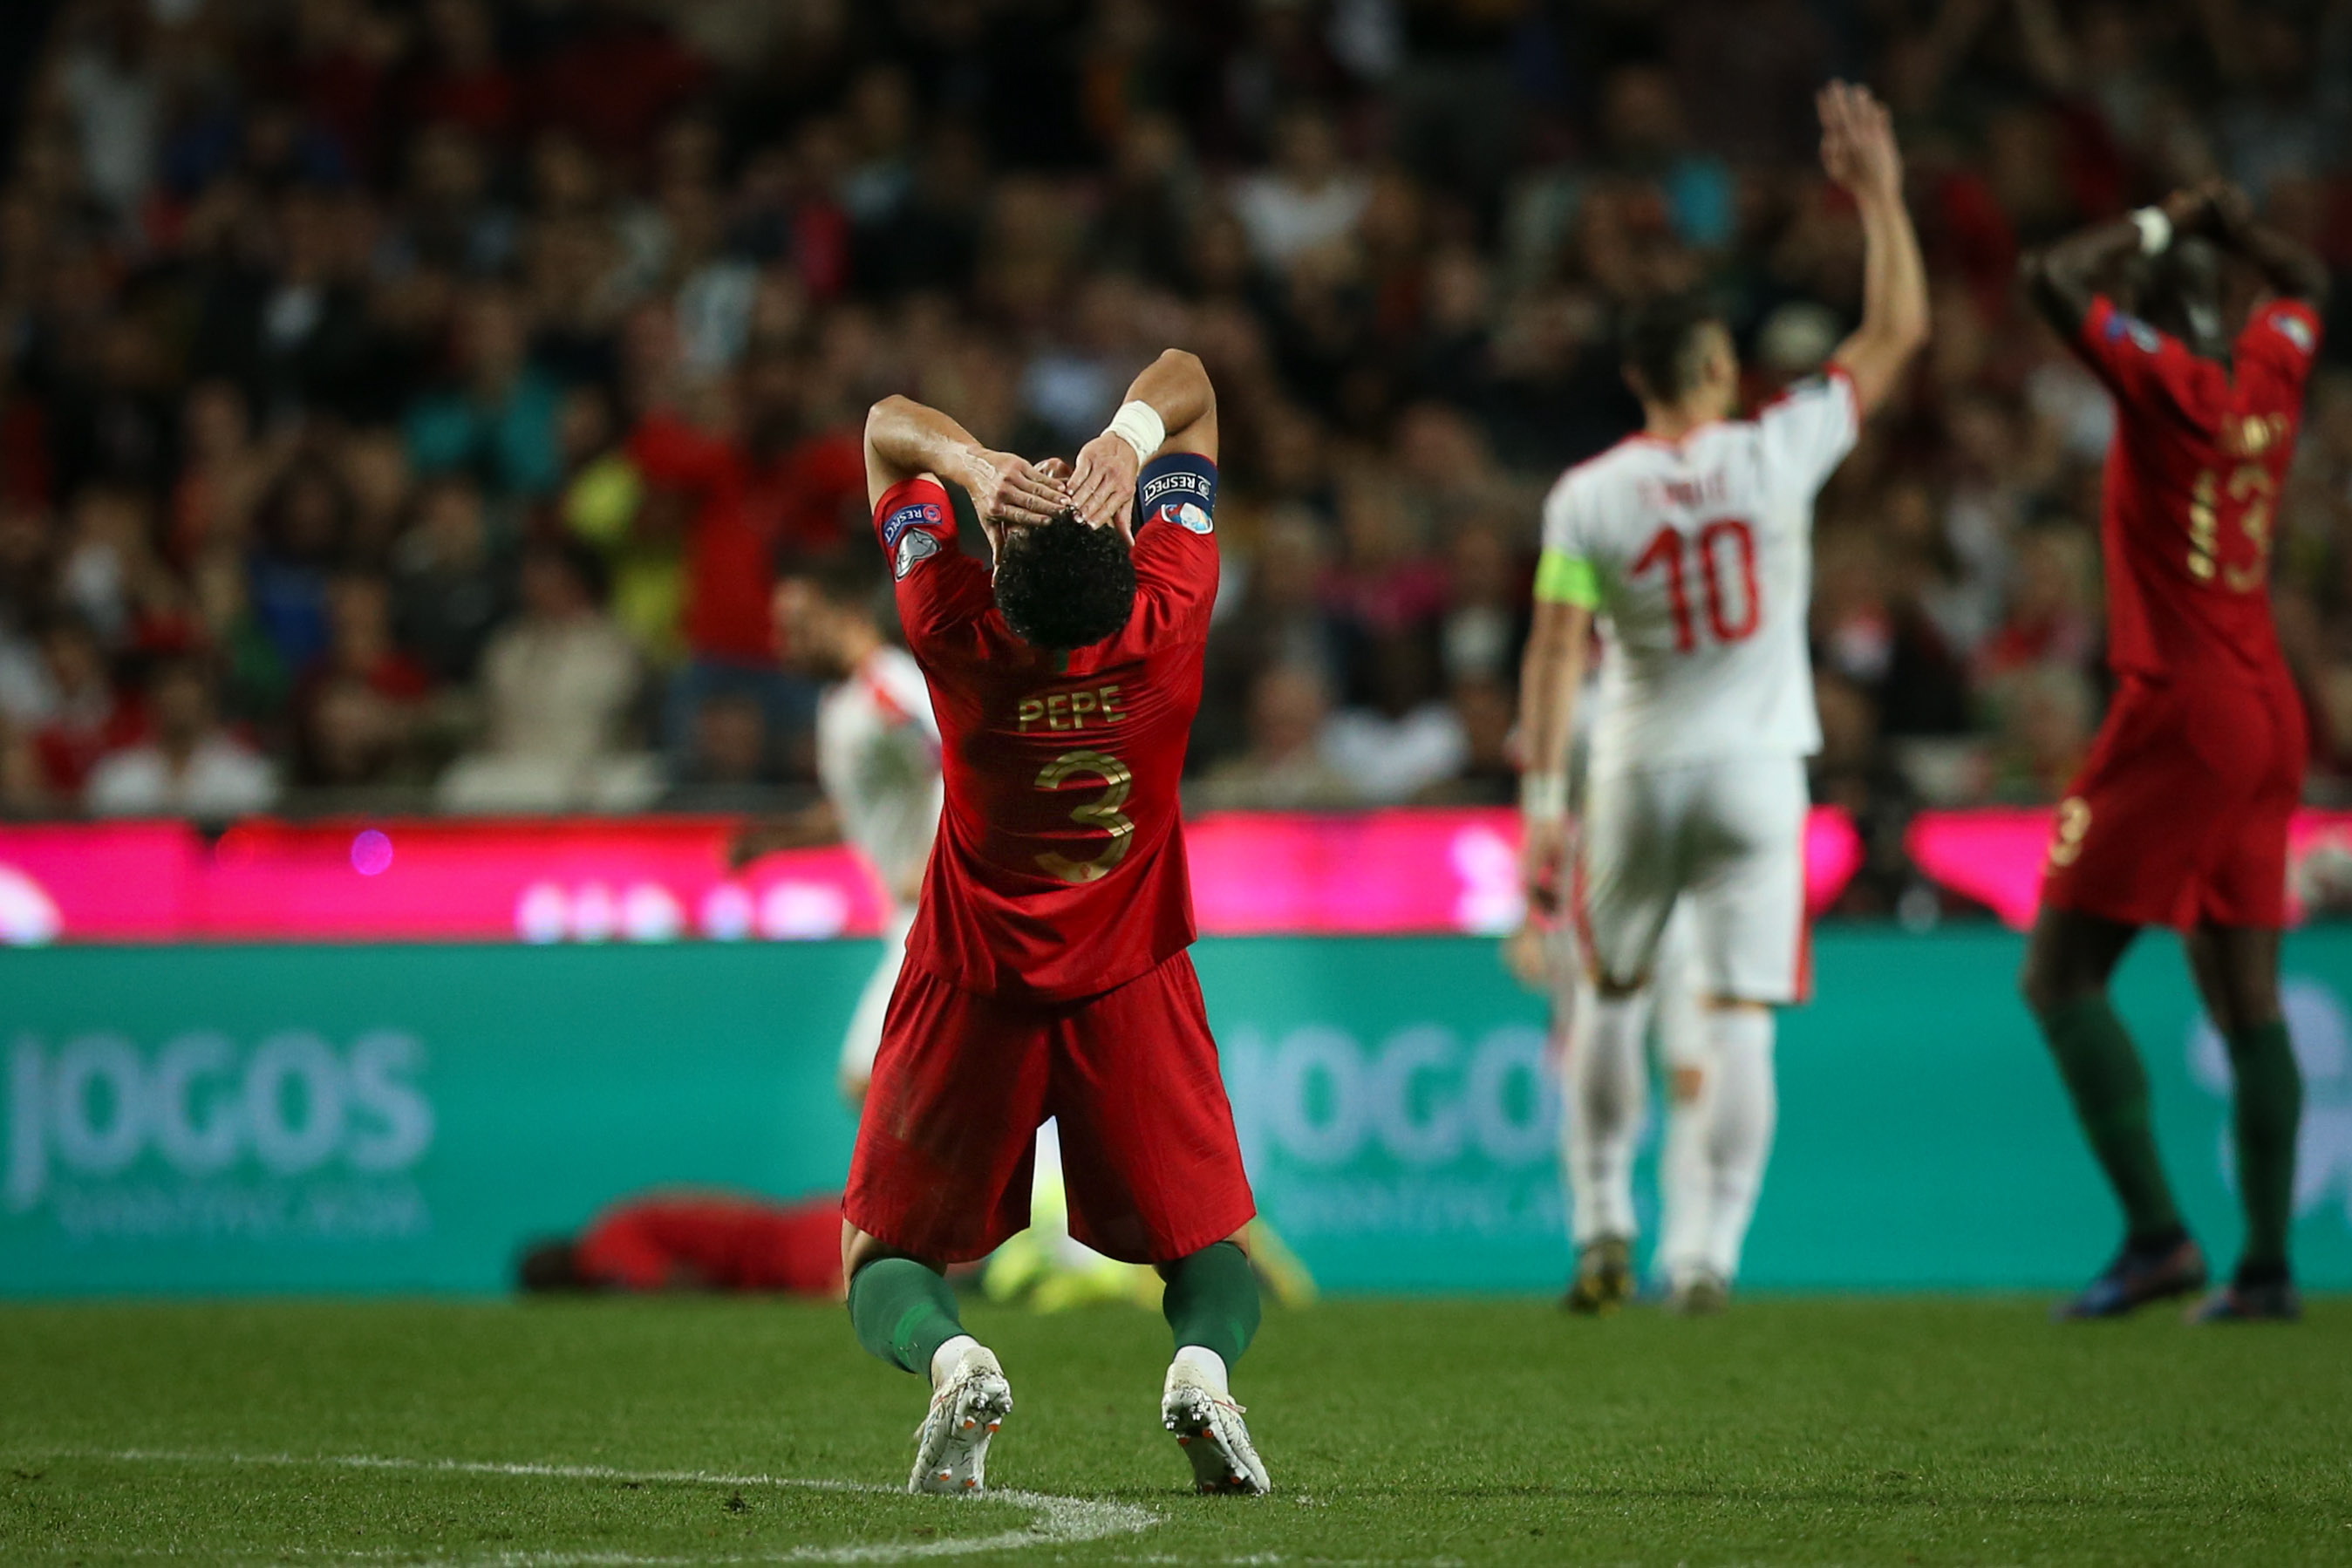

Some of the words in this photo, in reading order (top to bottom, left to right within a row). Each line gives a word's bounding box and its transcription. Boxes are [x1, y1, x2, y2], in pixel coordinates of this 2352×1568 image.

[1144, 475, 1196, 501] RESPECT
[1627, 517, 1762, 656] 10
[1018, 685, 1127, 733] PEPE
[1033, 749, 1135, 884] 3
[3, 1029, 435, 1214] JOGOS
[1224, 1023, 1570, 1199] JOGO
